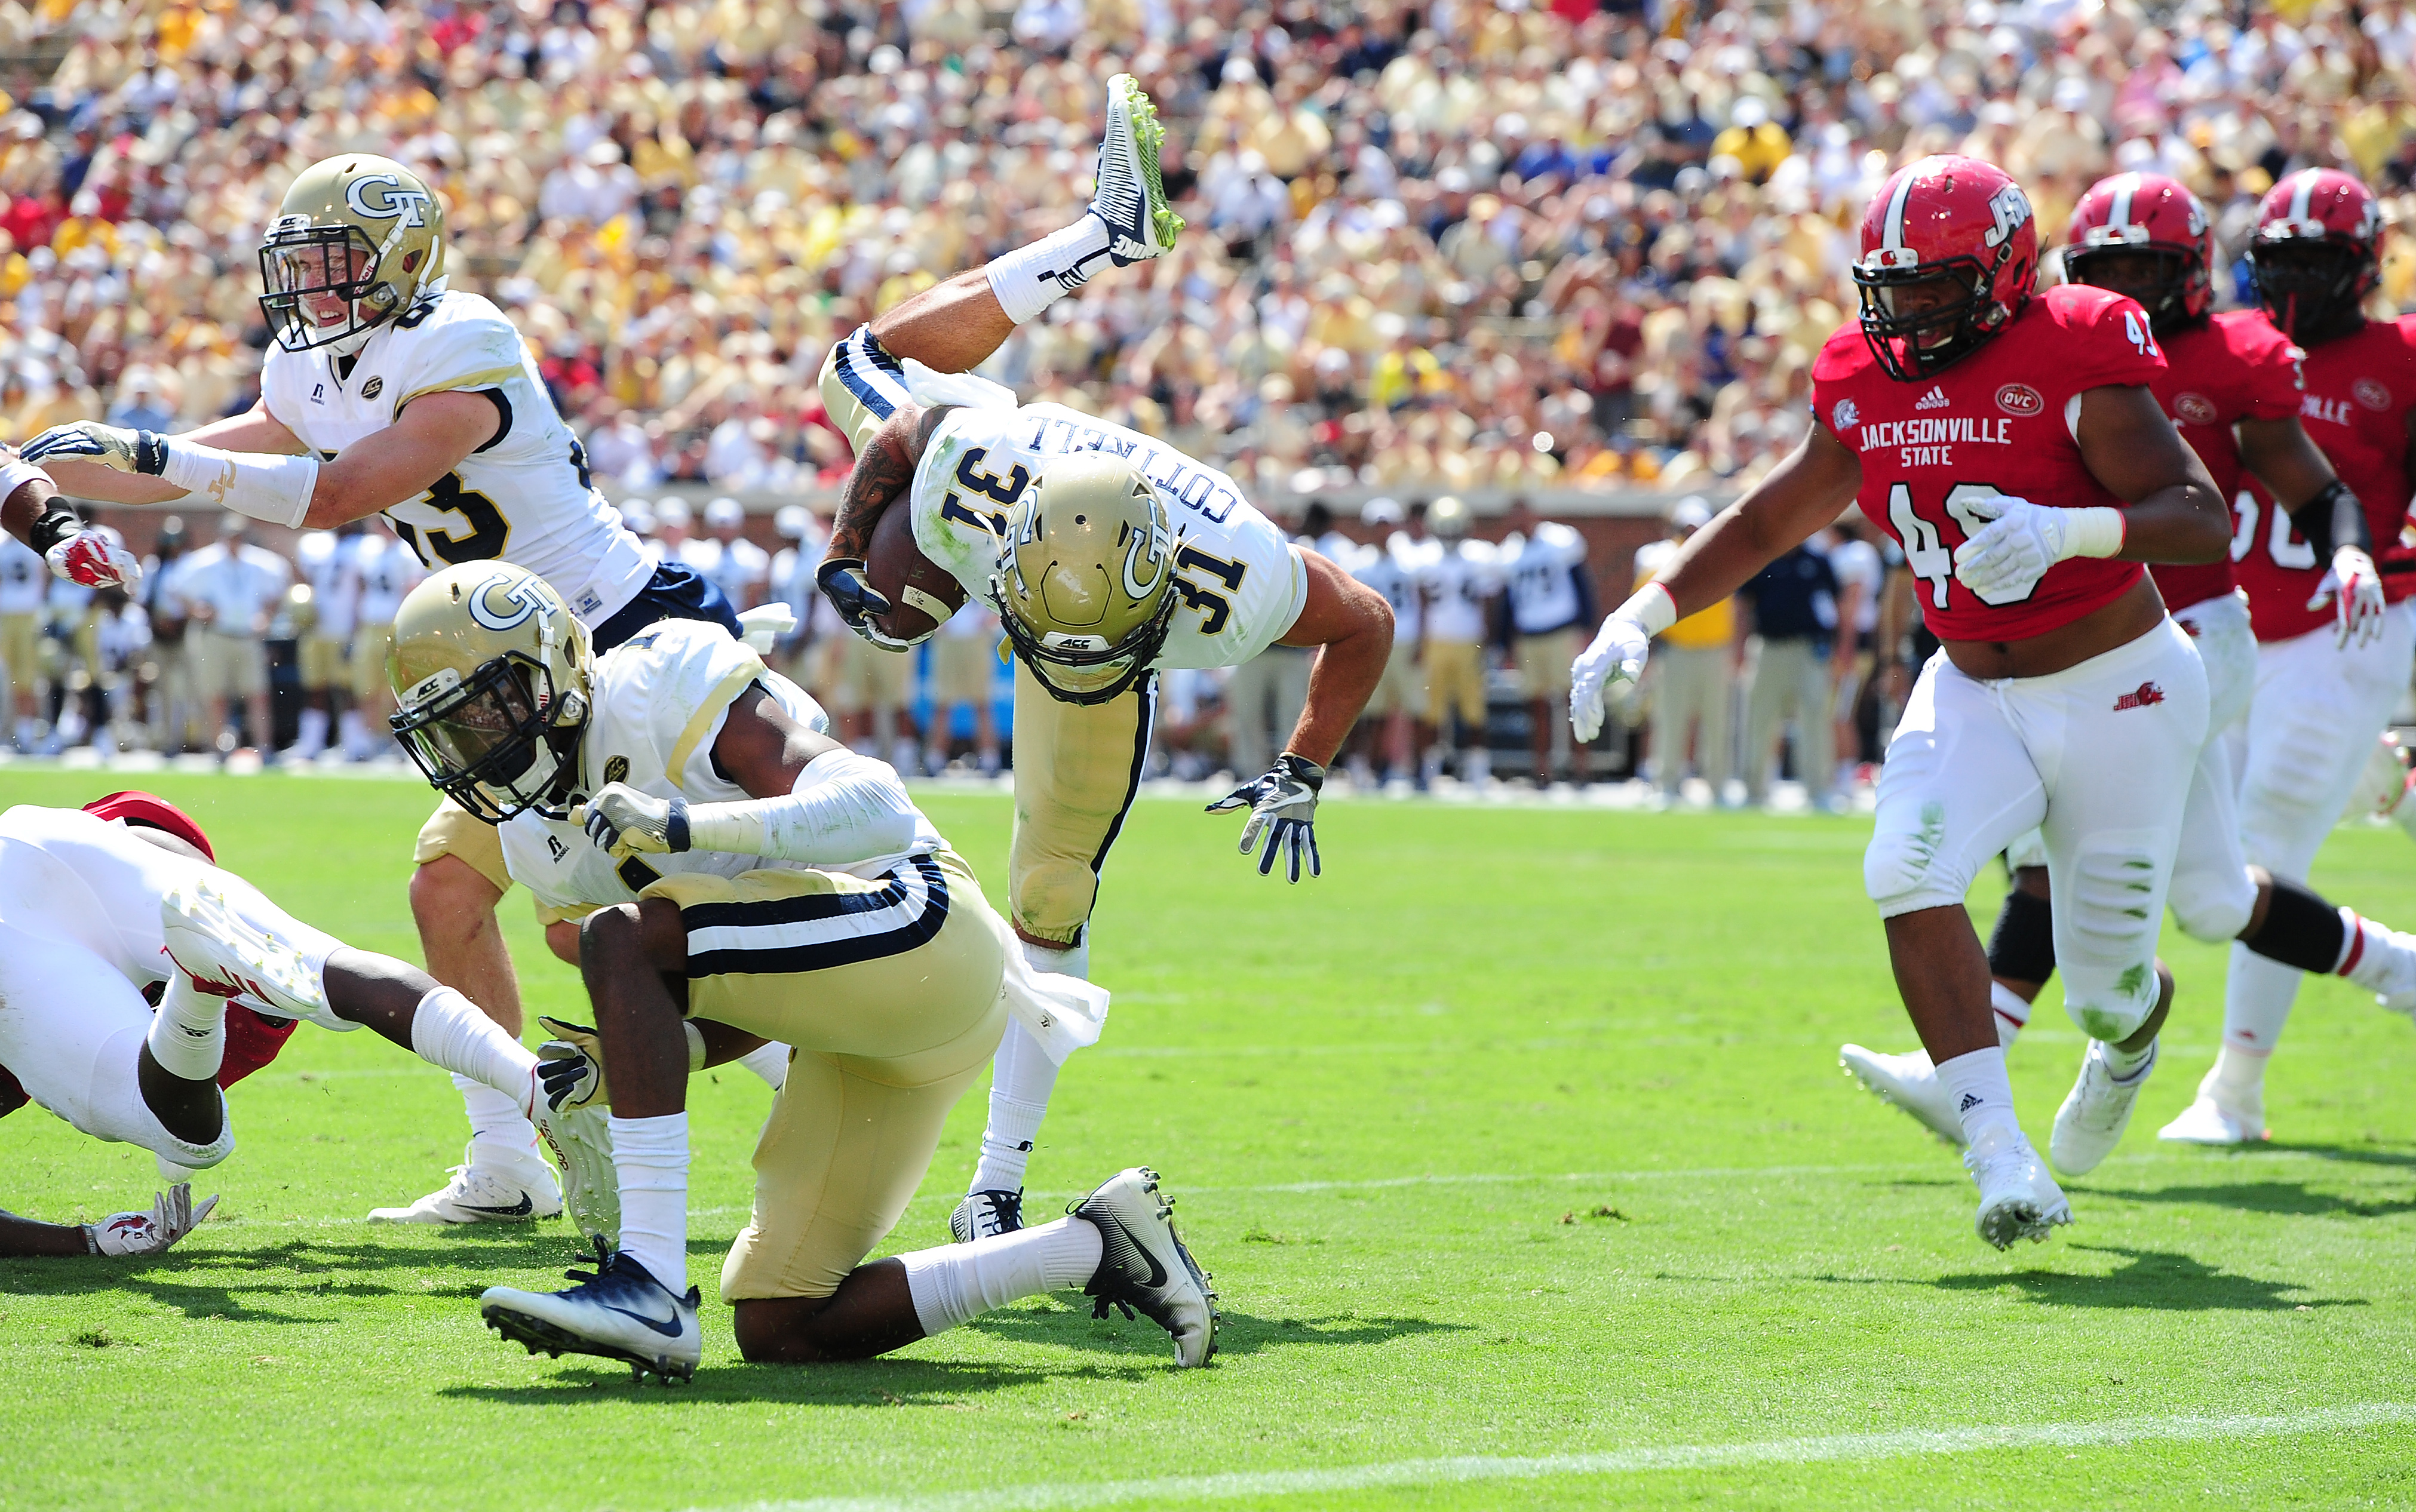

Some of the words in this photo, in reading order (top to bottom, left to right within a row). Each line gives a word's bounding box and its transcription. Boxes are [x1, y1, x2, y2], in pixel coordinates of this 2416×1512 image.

[345, 174, 430, 228] GT
[2003, 392, 2032, 408] OVC
[1859, 417, 2013, 453] JACKSONVILLE
[1901, 445, 1953, 468] STATE
[940, 444, 1032, 538] 31
[1026, 416, 1238, 524] COTTRELL
[469, 573, 558, 631] GT
[1172, 541, 1249, 637] 31
[1060, 638, 1091, 649] ACC
[417, 678, 439, 698] ACC
